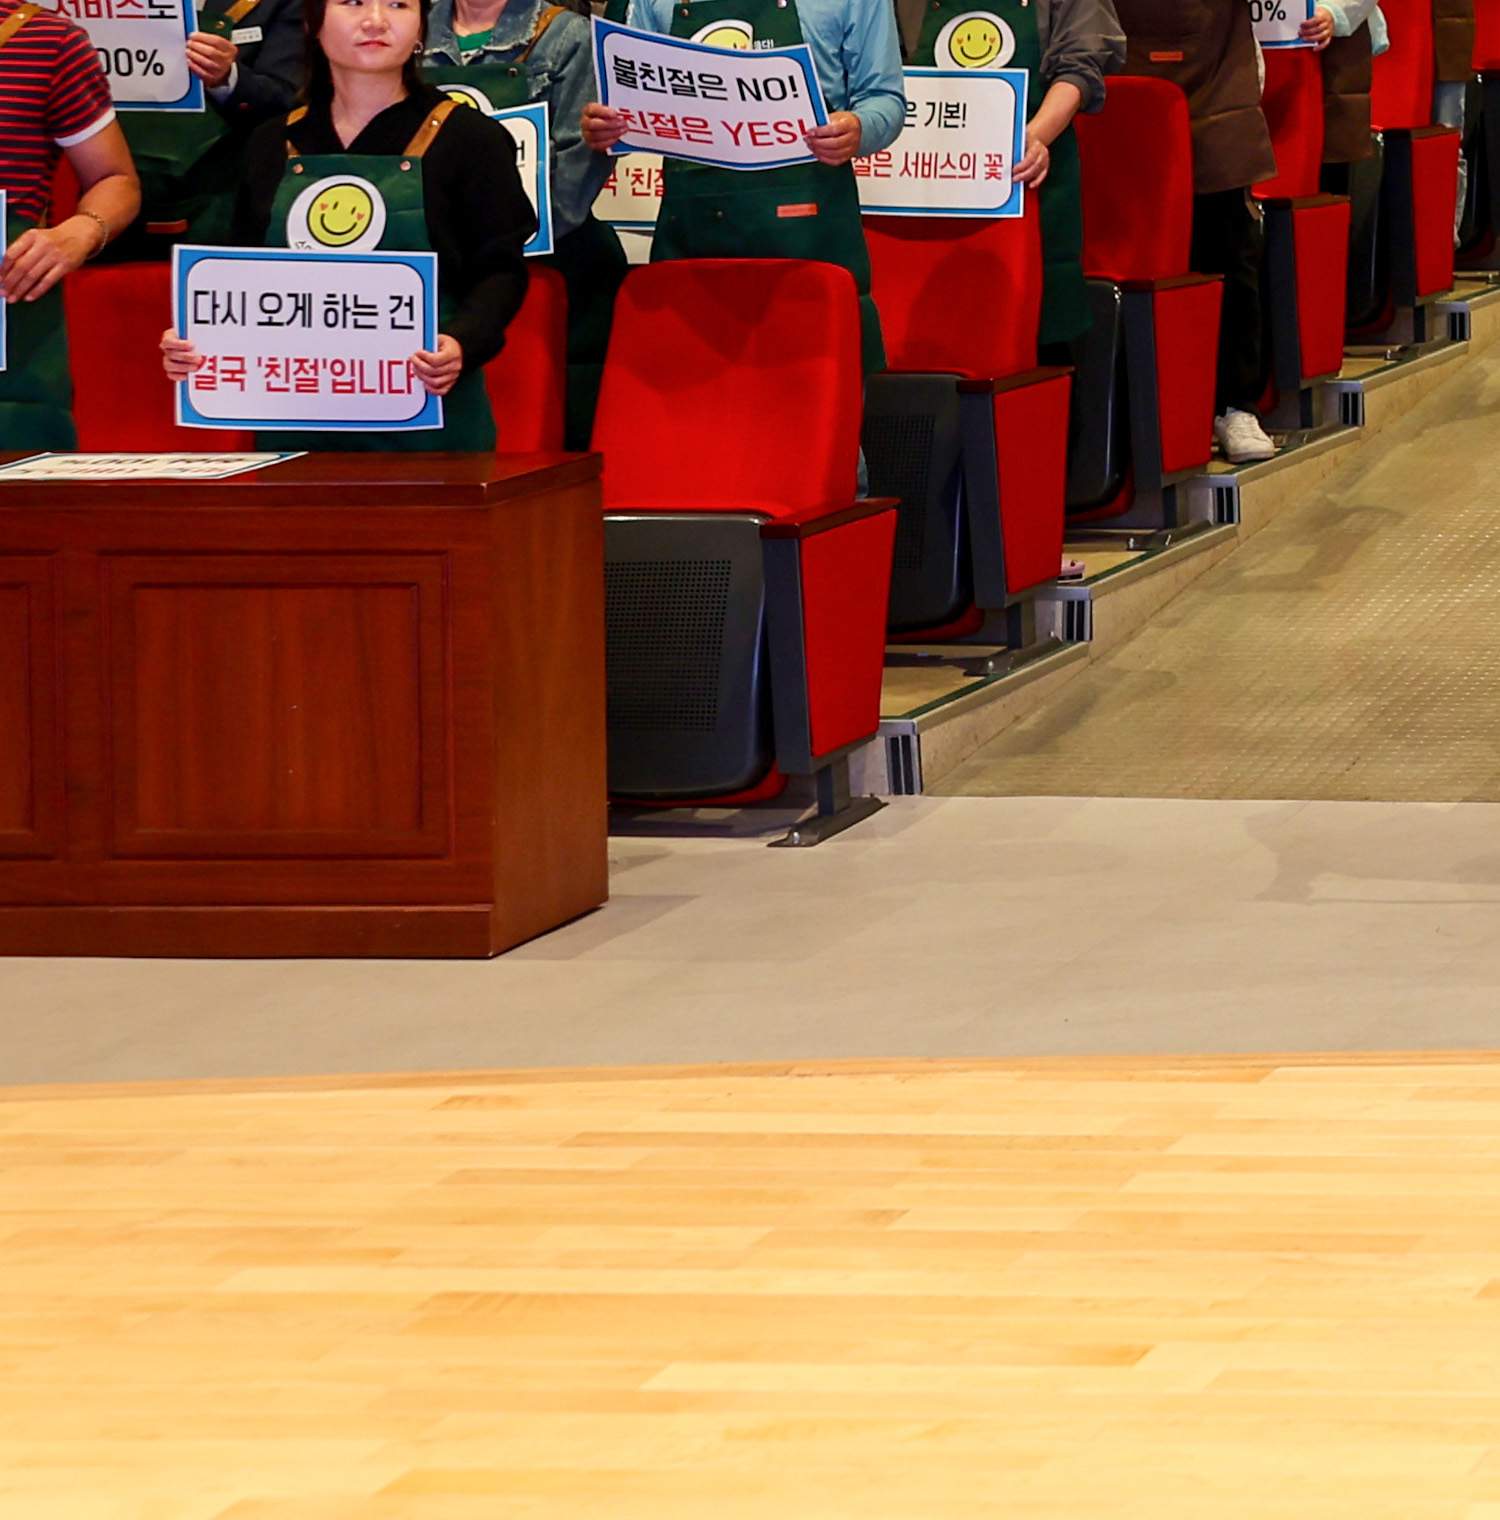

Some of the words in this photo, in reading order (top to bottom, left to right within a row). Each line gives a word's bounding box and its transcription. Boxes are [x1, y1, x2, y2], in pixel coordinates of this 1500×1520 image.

[613, 55, 728, 100] 불친절은
[736, 76, 798, 101] NO!
[720, 117, 809, 147] YES!
[925, 102, 966, 128] 기본!
[900, 152, 976, 179] 서비스의
[984, 154, 1003, 180] 꽃
[194, 290, 246, 326] 다시
[257, 293, 312, 328] 오게
[323, 294, 378, 329] 하는
[390, 296, 414, 330] 건
[195, 356, 246, 391] 결국
[258, 357, 416, 394] '친절'입니다
